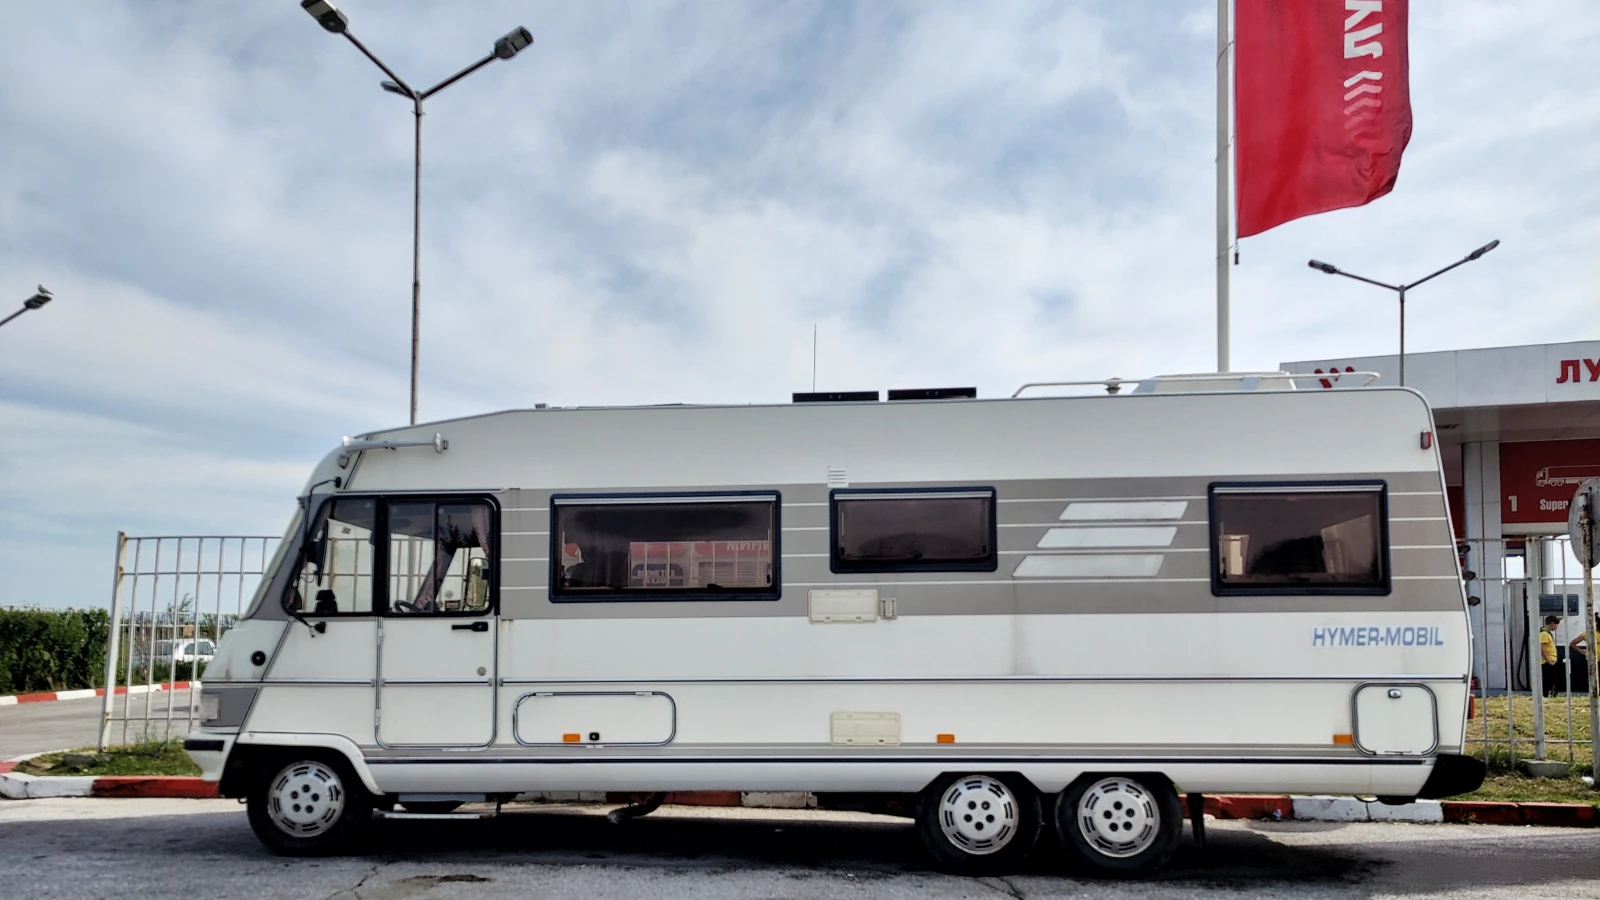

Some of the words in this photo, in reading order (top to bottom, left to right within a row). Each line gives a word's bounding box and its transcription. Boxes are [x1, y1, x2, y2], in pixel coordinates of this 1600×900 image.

[1556, 358, 1600, 384] ЛУ
[1508, 495, 1518, 512] 1
[1539, 498, 1569, 512] Super
